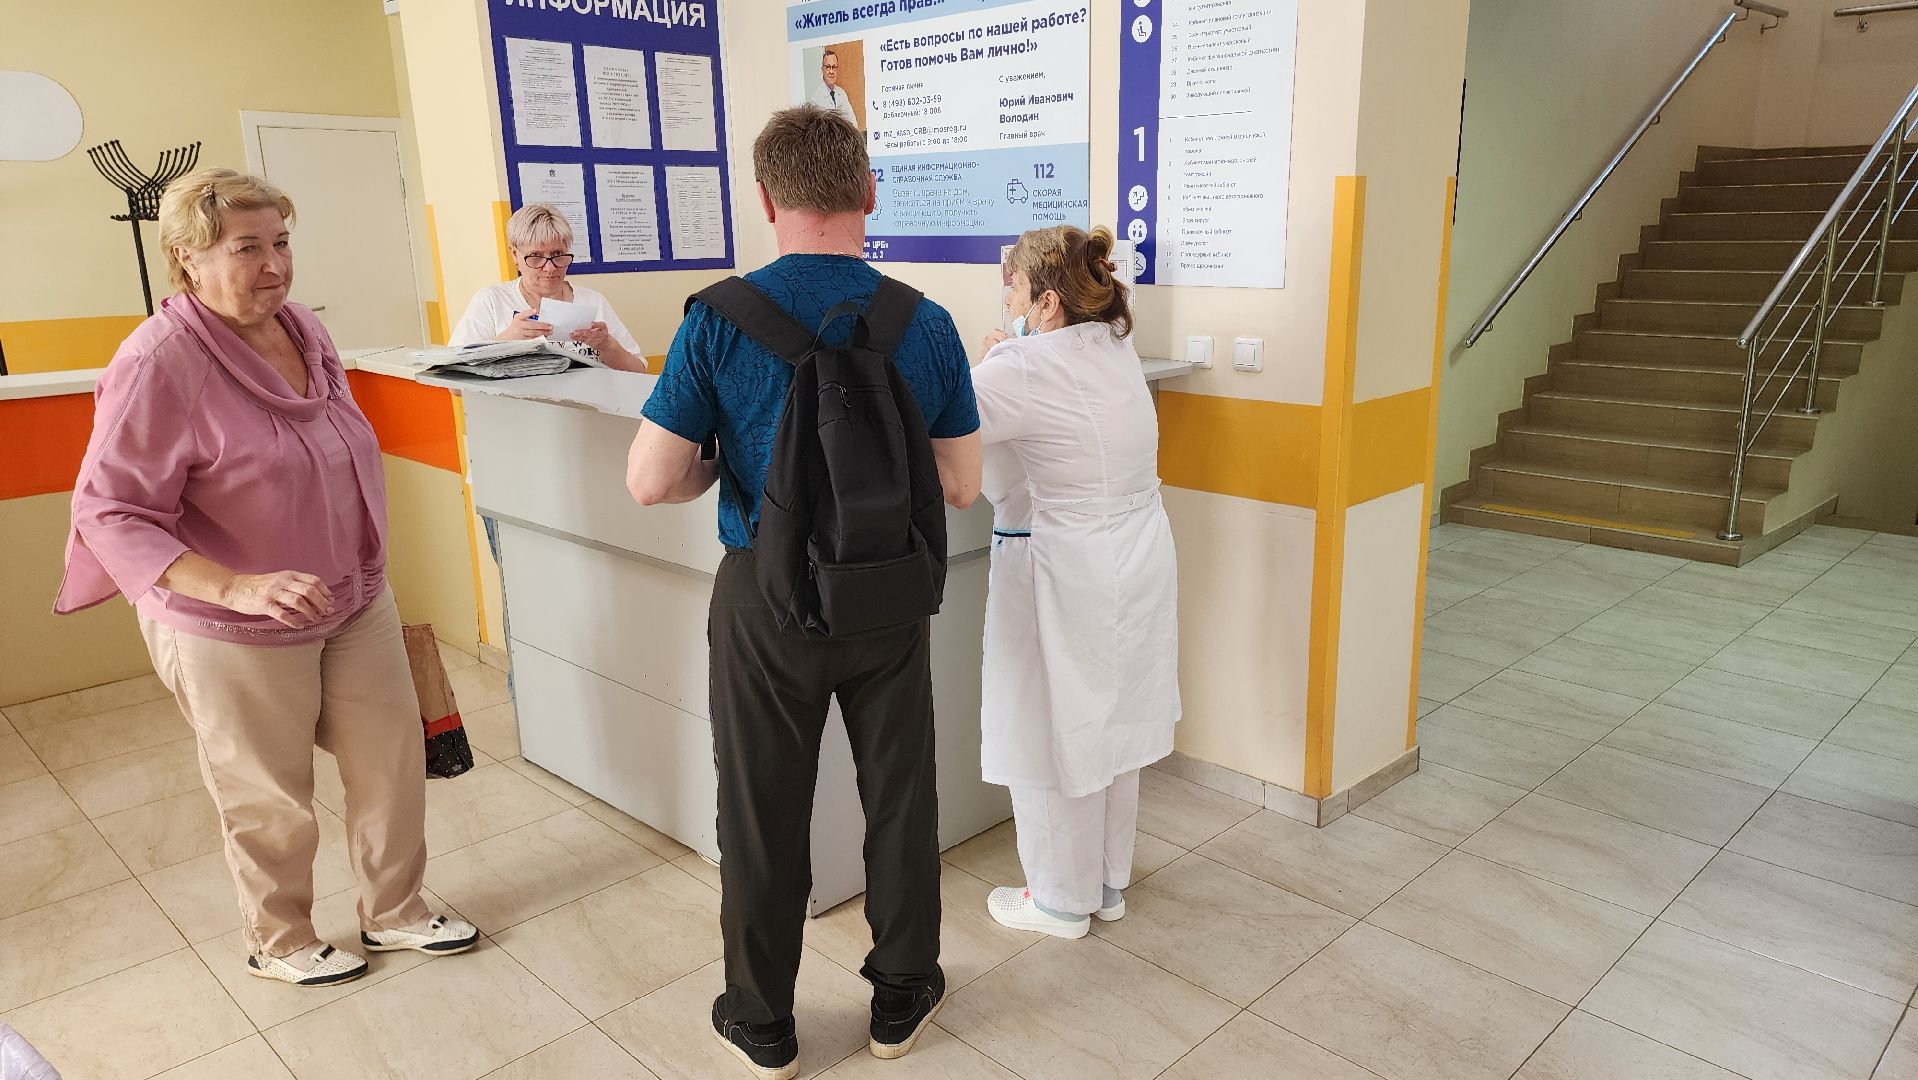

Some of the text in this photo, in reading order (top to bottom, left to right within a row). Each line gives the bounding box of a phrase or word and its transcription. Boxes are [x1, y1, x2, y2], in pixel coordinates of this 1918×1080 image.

[504, 0, 706, 28] ОРМАЦИЯ
[795, 0, 945, 30] «Житель всегда прав
[880, 7, 1087, 52] «Есть вопросы по нашей работе?
[881, 38, 1038, 72] Готов помочь Вам лично!»
[999, 92, 1074, 109] Юрий Иванович
[999, 112, 1039, 124] Володин
[999, 130, 1028, 140] Главный
[1133, 126, 1145, 162] 1
[891, 164, 916, 174] ЕДИНАЯ
[1033, 162, 1055, 179] 112
[1032, 188, 1062, 198] СКОРАЯ
[1032, 199, 1088, 210] МЕДИЦИНСКАЯ
[1032, 212, 1067, 222] ПОМОЩЬ
